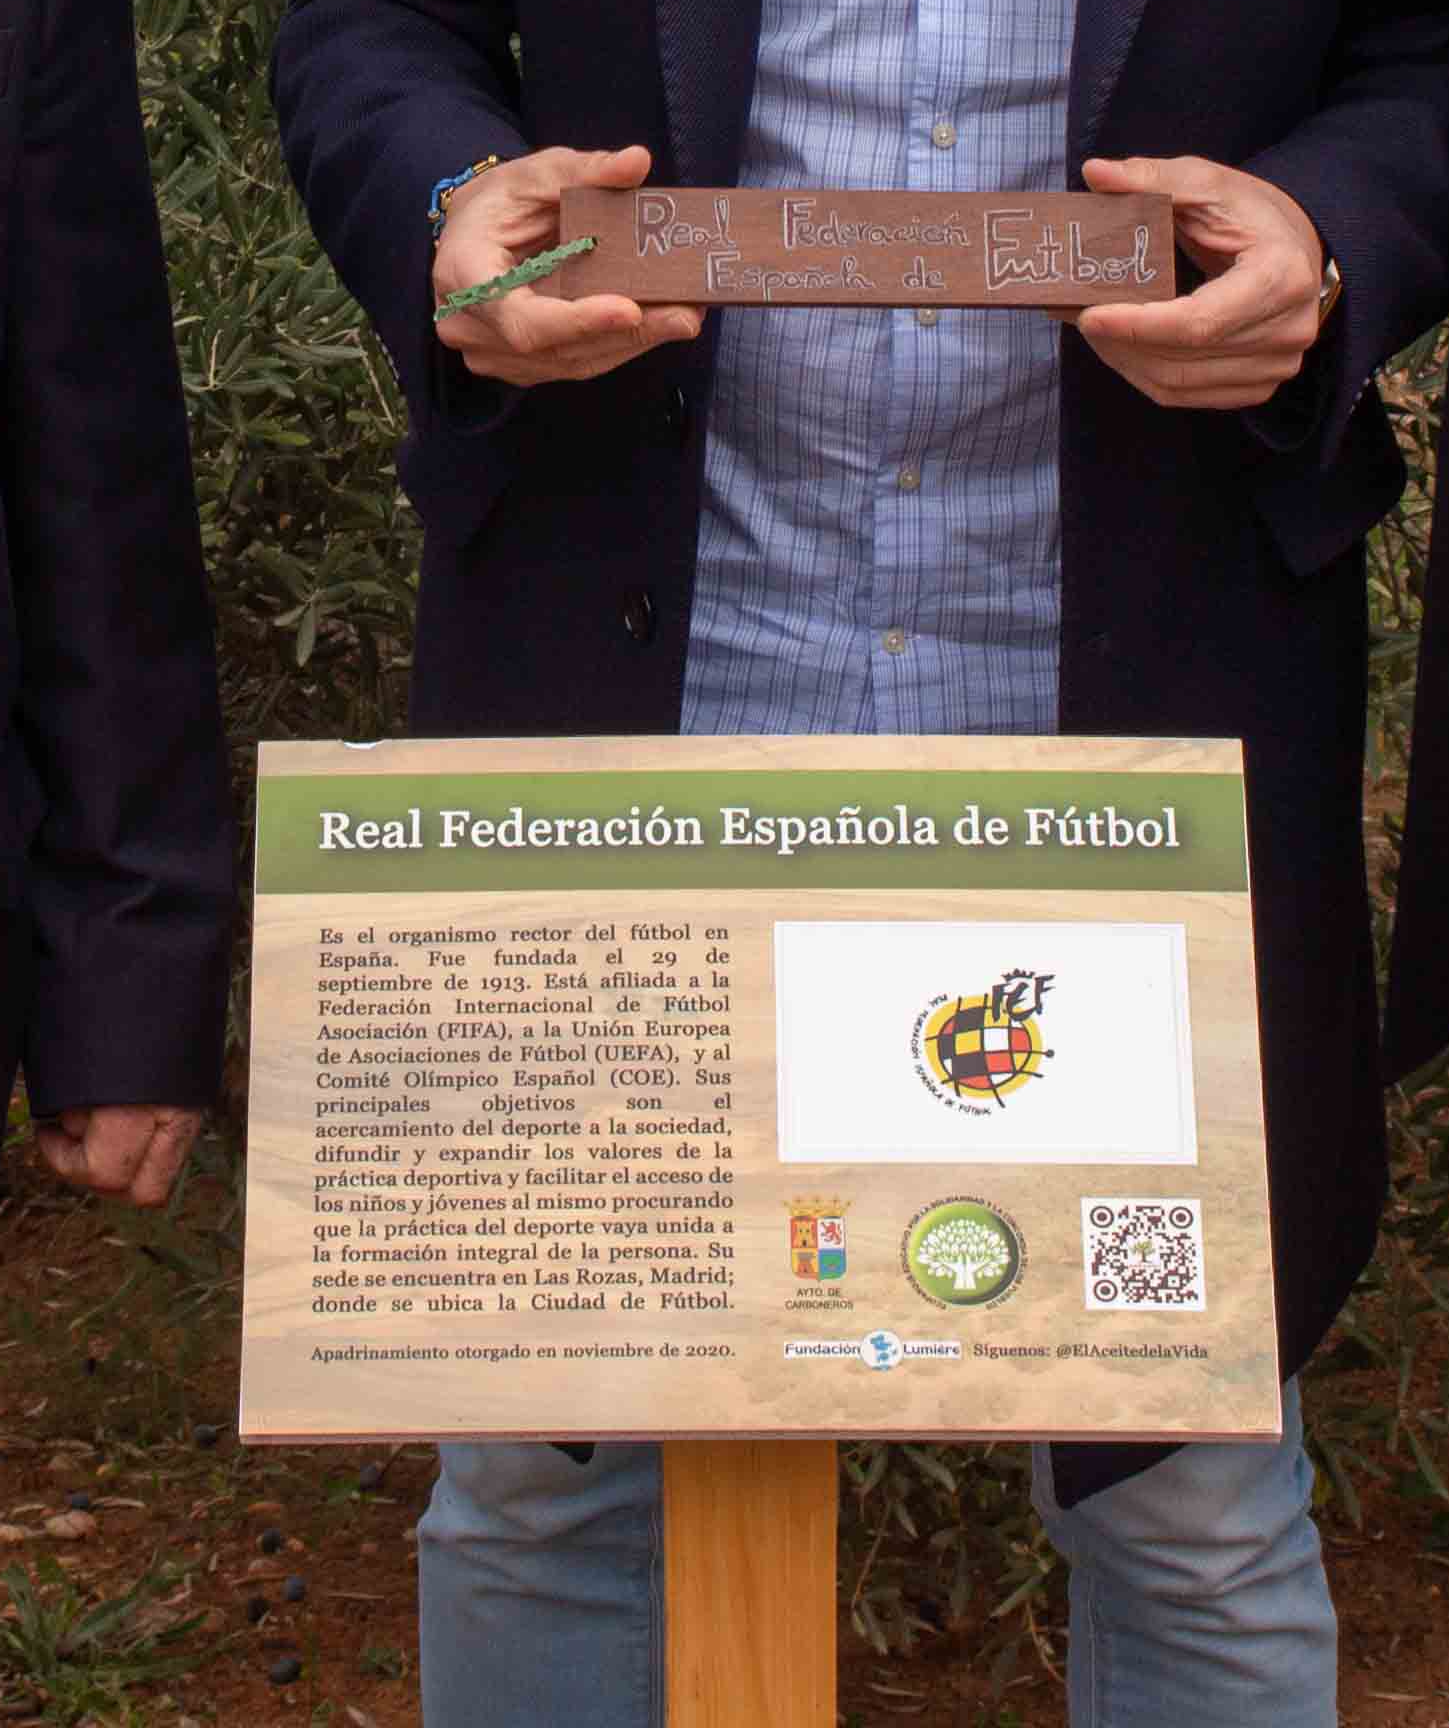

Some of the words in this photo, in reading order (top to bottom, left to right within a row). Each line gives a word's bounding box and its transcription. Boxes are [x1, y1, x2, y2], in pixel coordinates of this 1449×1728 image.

[635, 193, 735, 256] Real
[903, 256, 946, 288] de
[318, 809, 424, 851] Real
[439, 806, 705, 850] Federación
[719, 806, 939, 855] Española
[953, 806, 1010, 847] de
[1024, 806, 1181, 848] Fútbol
[319, 928, 344, 944] Es
[357, 927, 375, 944] el
[388, 927, 496, 946] organismo
[510, 928, 572, 942] rector
[585, 925, 615, 941] del
[630, 924, 691, 941] fútbol
[705, 927, 729, 940] en
[319, 952, 399, 972] España.
[429, 952, 466, 967] Fue
[494, 950, 577, 966] fundada
[605, 949, 623, 964] el
[652, 951, 677, 968] 29
[705, 949, 729, 964] de
[317, 975, 432, 995] septiembre
[444, 975, 468, 990] de
[481, 977, 531, 993] 1913.
[544, 973, 588, 990] Está
[600, 972, 677, 988] afiliada
[689, 977, 699, 988] a
[712, 972, 729, 988] la
[318, 999, 431, 1015] Federación
[455, 997, 593, 1014] Internacional
[616, 997, 641, 1013] de
[664, 995, 730, 1013] Fútbol
[316, 1022, 427, 1041] Asociación
[437, 1021, 512, 1041] (FIFA),
[523, 1025, 534, 1038] a
[544, 1021, 561, 1038] la
[572, 1021, 634, 1038] Unión
[645, 1021, 730, 1041] Europea
[316, 1048, 341, 1064] de
[349, 1046, 480, 1064] Asociaciones
[488, 1046, 512, 1062] de
[520, 1044, 587, 1062] Fútbol
[595, 1044, 680, 1064] (UEFA),
[693, 1047, 705, 1064] y
[712, 1044, 730, 1060] al
[316, 1072, 390, 1089] Comité
[404, 1070, 499, 1091] Olímpico
[513, 1069, 595, 1090] Español
[610, 1069, 680, 1088] (COE).
[695, 1069, 731, 1086] Sus
[315, 1095, 431, 1118] principales
[481, 1094, 576, 1114] objetivos
[626, 1095, 662, 1109] son
[713, 1093, 731, 1109] el
[314, 1121, 454, 1138] acercamiento
[462, 1119, 493, 1136] del
[501, 1119, 581, 1140] deporte
[590, 1122, 600, 1135] a
[608, 1118, 627, 1135] la
[635, 1118, 733, 1137] sociedad,
[314, 1145, 400, 1162] difundir
[413, 1147, 426, 1164] y
[439, 1144, 531, 1164] expandir
[545, 1144, 574, 1159] los
[588, 1144, 662, 1159] valores
[676, 1143, 701, 1159] de
[713, 1143, 732, 1159] la
[314, 1169, 398, 1190] práctica
[403, 1169, 502, 1190] deportiva
[505, 1172, 519, 1188] y
[525, 1169, 607, 1185] facilitar
[611, 1168, 630, 1185] el
[636, 1171, 703, 1185] acceso
[708, 1167, 733, 1185] de
[314, 1195, 343, 1213] los
[349, 1195, 406, 1213] niños
[410, 1198, 422, 1215] y
[426, 1194, 507, 1215] jóvenes
[511, 1193, 530, 1210] al
[536, 1195, 607, 1210] mismo
[611, 1192, 734, 1213] procurando
[313, 1223, 351, 1241] que
[359, 1221, 377, 1238] la
[384, 1219, 468, 1240] práctica
[475, 1218, 506, 1235] del
[513, 1218, 594, 1238] deporte
[601, 1221, 648, 1237] vaya
[656, 1218, 715, 1234] unida
[722, 1221, 733, 1233] a
[313, 1245, 330, 1263] la
[341, 1244, 447, 1262] formación
[456, 1243, 538, 1264] integral
[547, 1243, 572, 1260] de
[581, 1242, 599, 1259] la
[609, 1245, 698, 1263] persona.
[708, 1242, 734, 1259] Su
[311, 1270, 359, 1288] sede
[364, 1274, 386, 1287] se
[391, 1272, 496, 1286] encuentra
[502, 1272, 528, 1286] en
[535, 1269, 569, 1286] Las
[576, 1268, 643, 1287] Rozas,
[651, 1267, 734, 1287] Madrid;
[311, 1295, 377, 1313] donde
[391, 1299, 413, 1312] se
[427, 1295, 483, 1311] ubica
[498, 1294, 516, 1310] la
[531, 1293, 606, 1310] Ciudad
[620, 1292, 646, 1310] de
[660, 1291, 734, 1310] Fútbol.
[827, 1288, 841, 1296] DE
[785, 1300, 854, 1310] CARBONEROS
[311, 1345, 449, 1364] Apadrinamiento
[455, 1344, 531, 1362] otorgado
[537, 1346, 556, 1359] en
[563, 1343, 653, 1359] noviembre
[659, 1342, 680, 1358] de
[685, 1344, 735, 1358] 2020.
[974, 1343, 1050, 1361] Síguenos:
[1056, 1344, 1209, 1360] @ElAceitedelaVida
